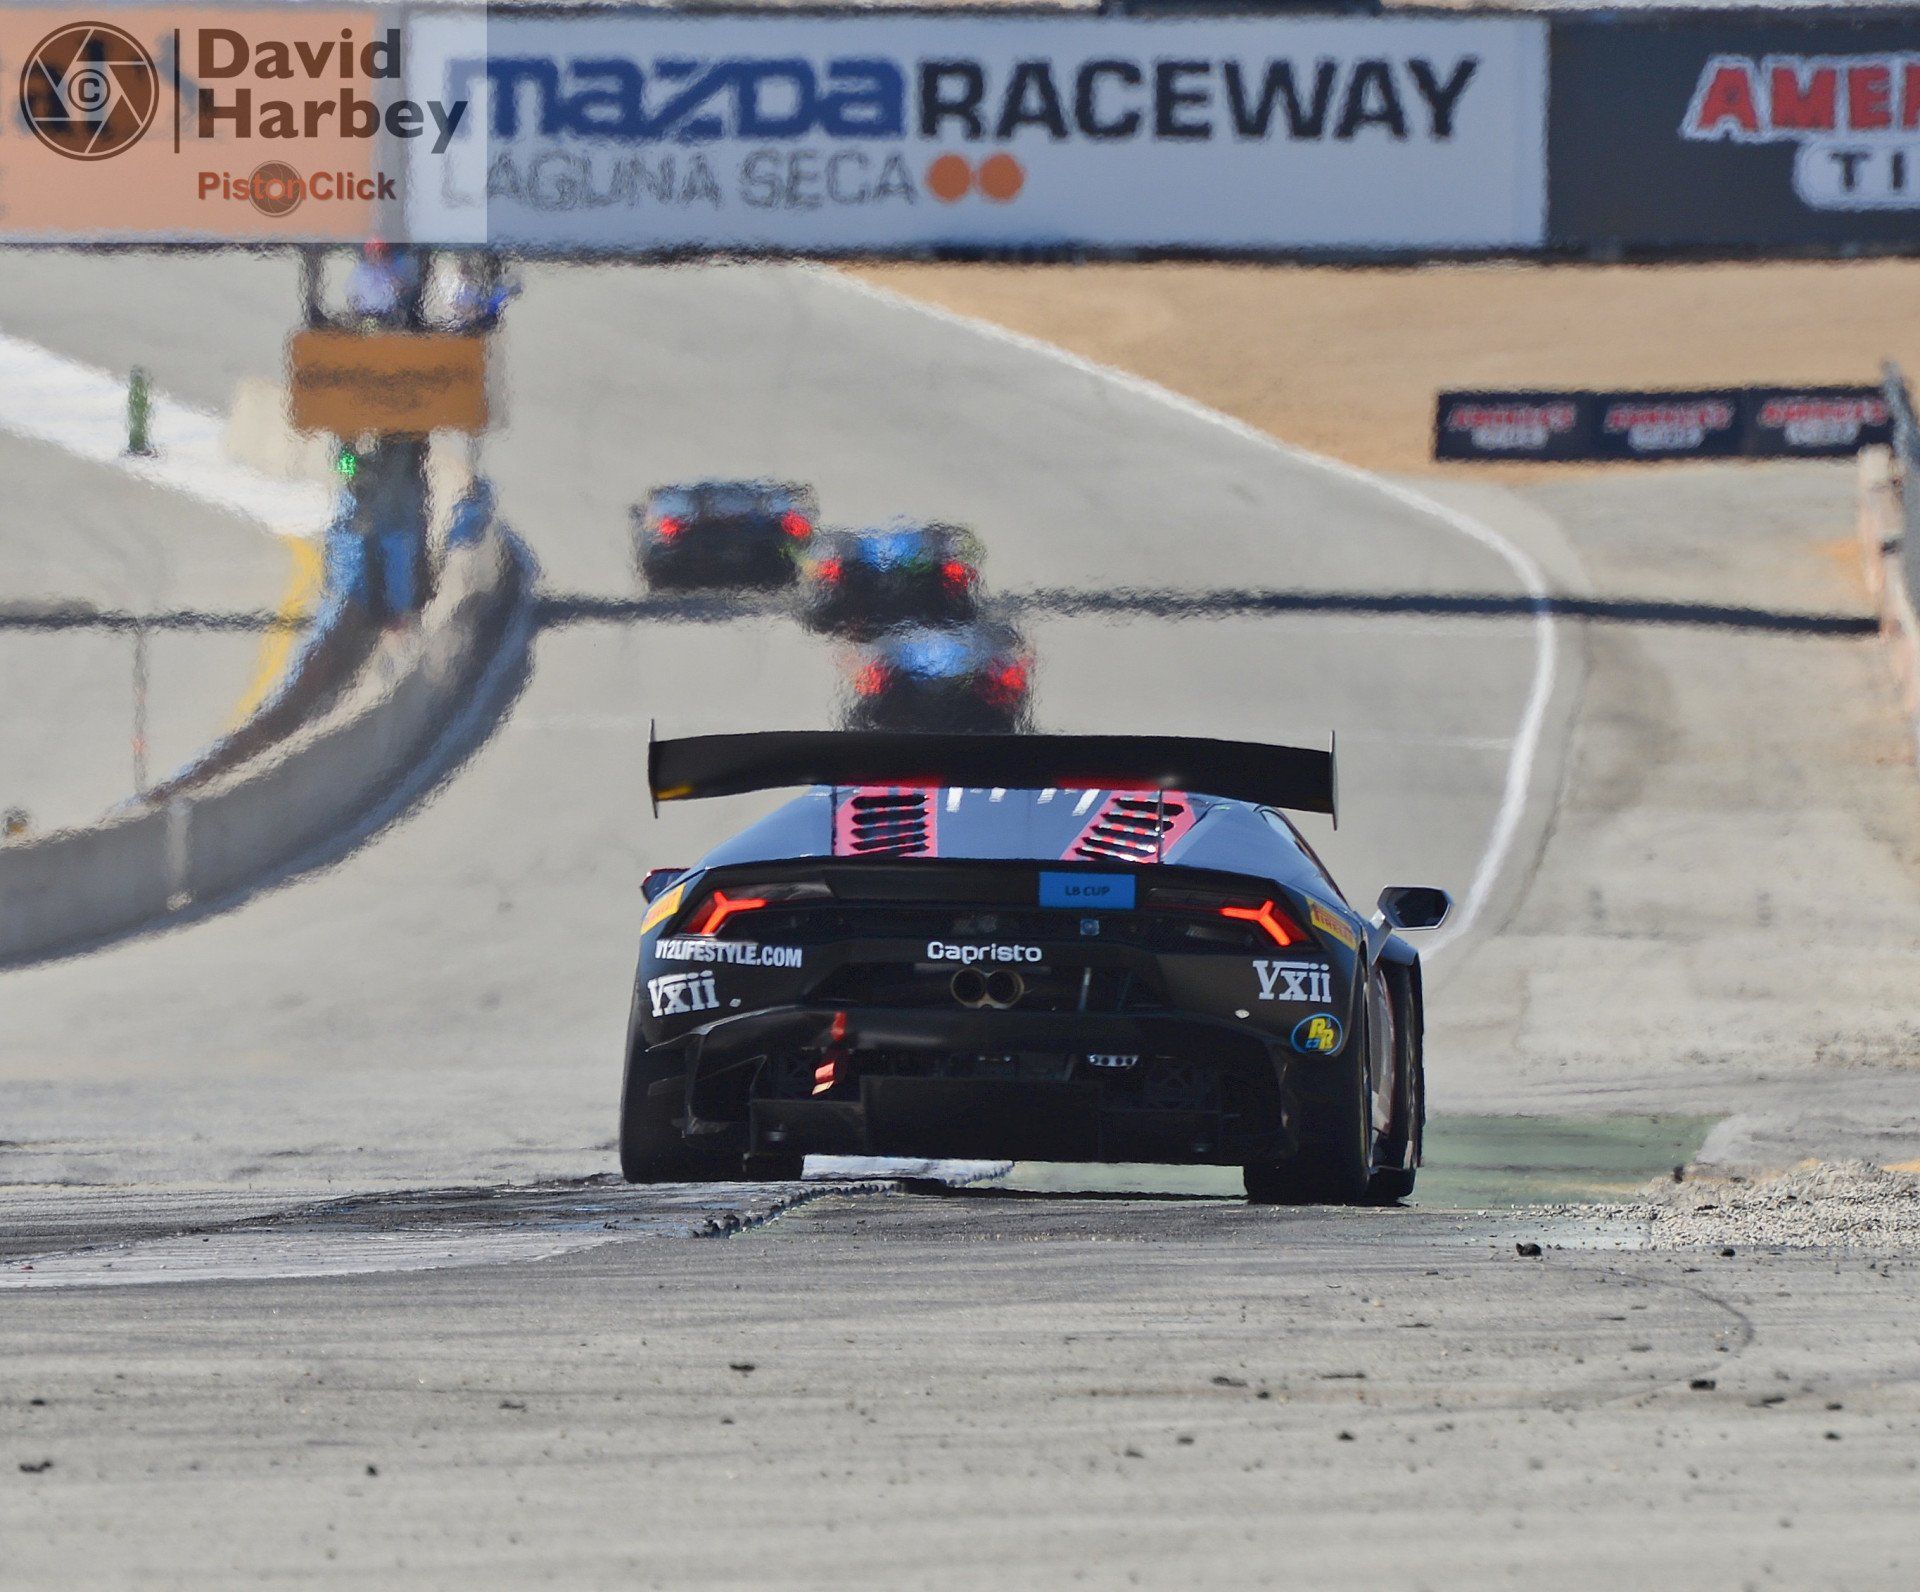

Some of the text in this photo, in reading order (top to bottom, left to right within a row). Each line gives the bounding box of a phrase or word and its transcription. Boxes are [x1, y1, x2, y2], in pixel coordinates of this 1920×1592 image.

[917, 56, 1479, 141] RACEWAY
[441, 149, 919, 209] LAGUNA SECA
[1083, 885, 1111, 897] CUP
[927, 941, 1042, 964] Capristo
